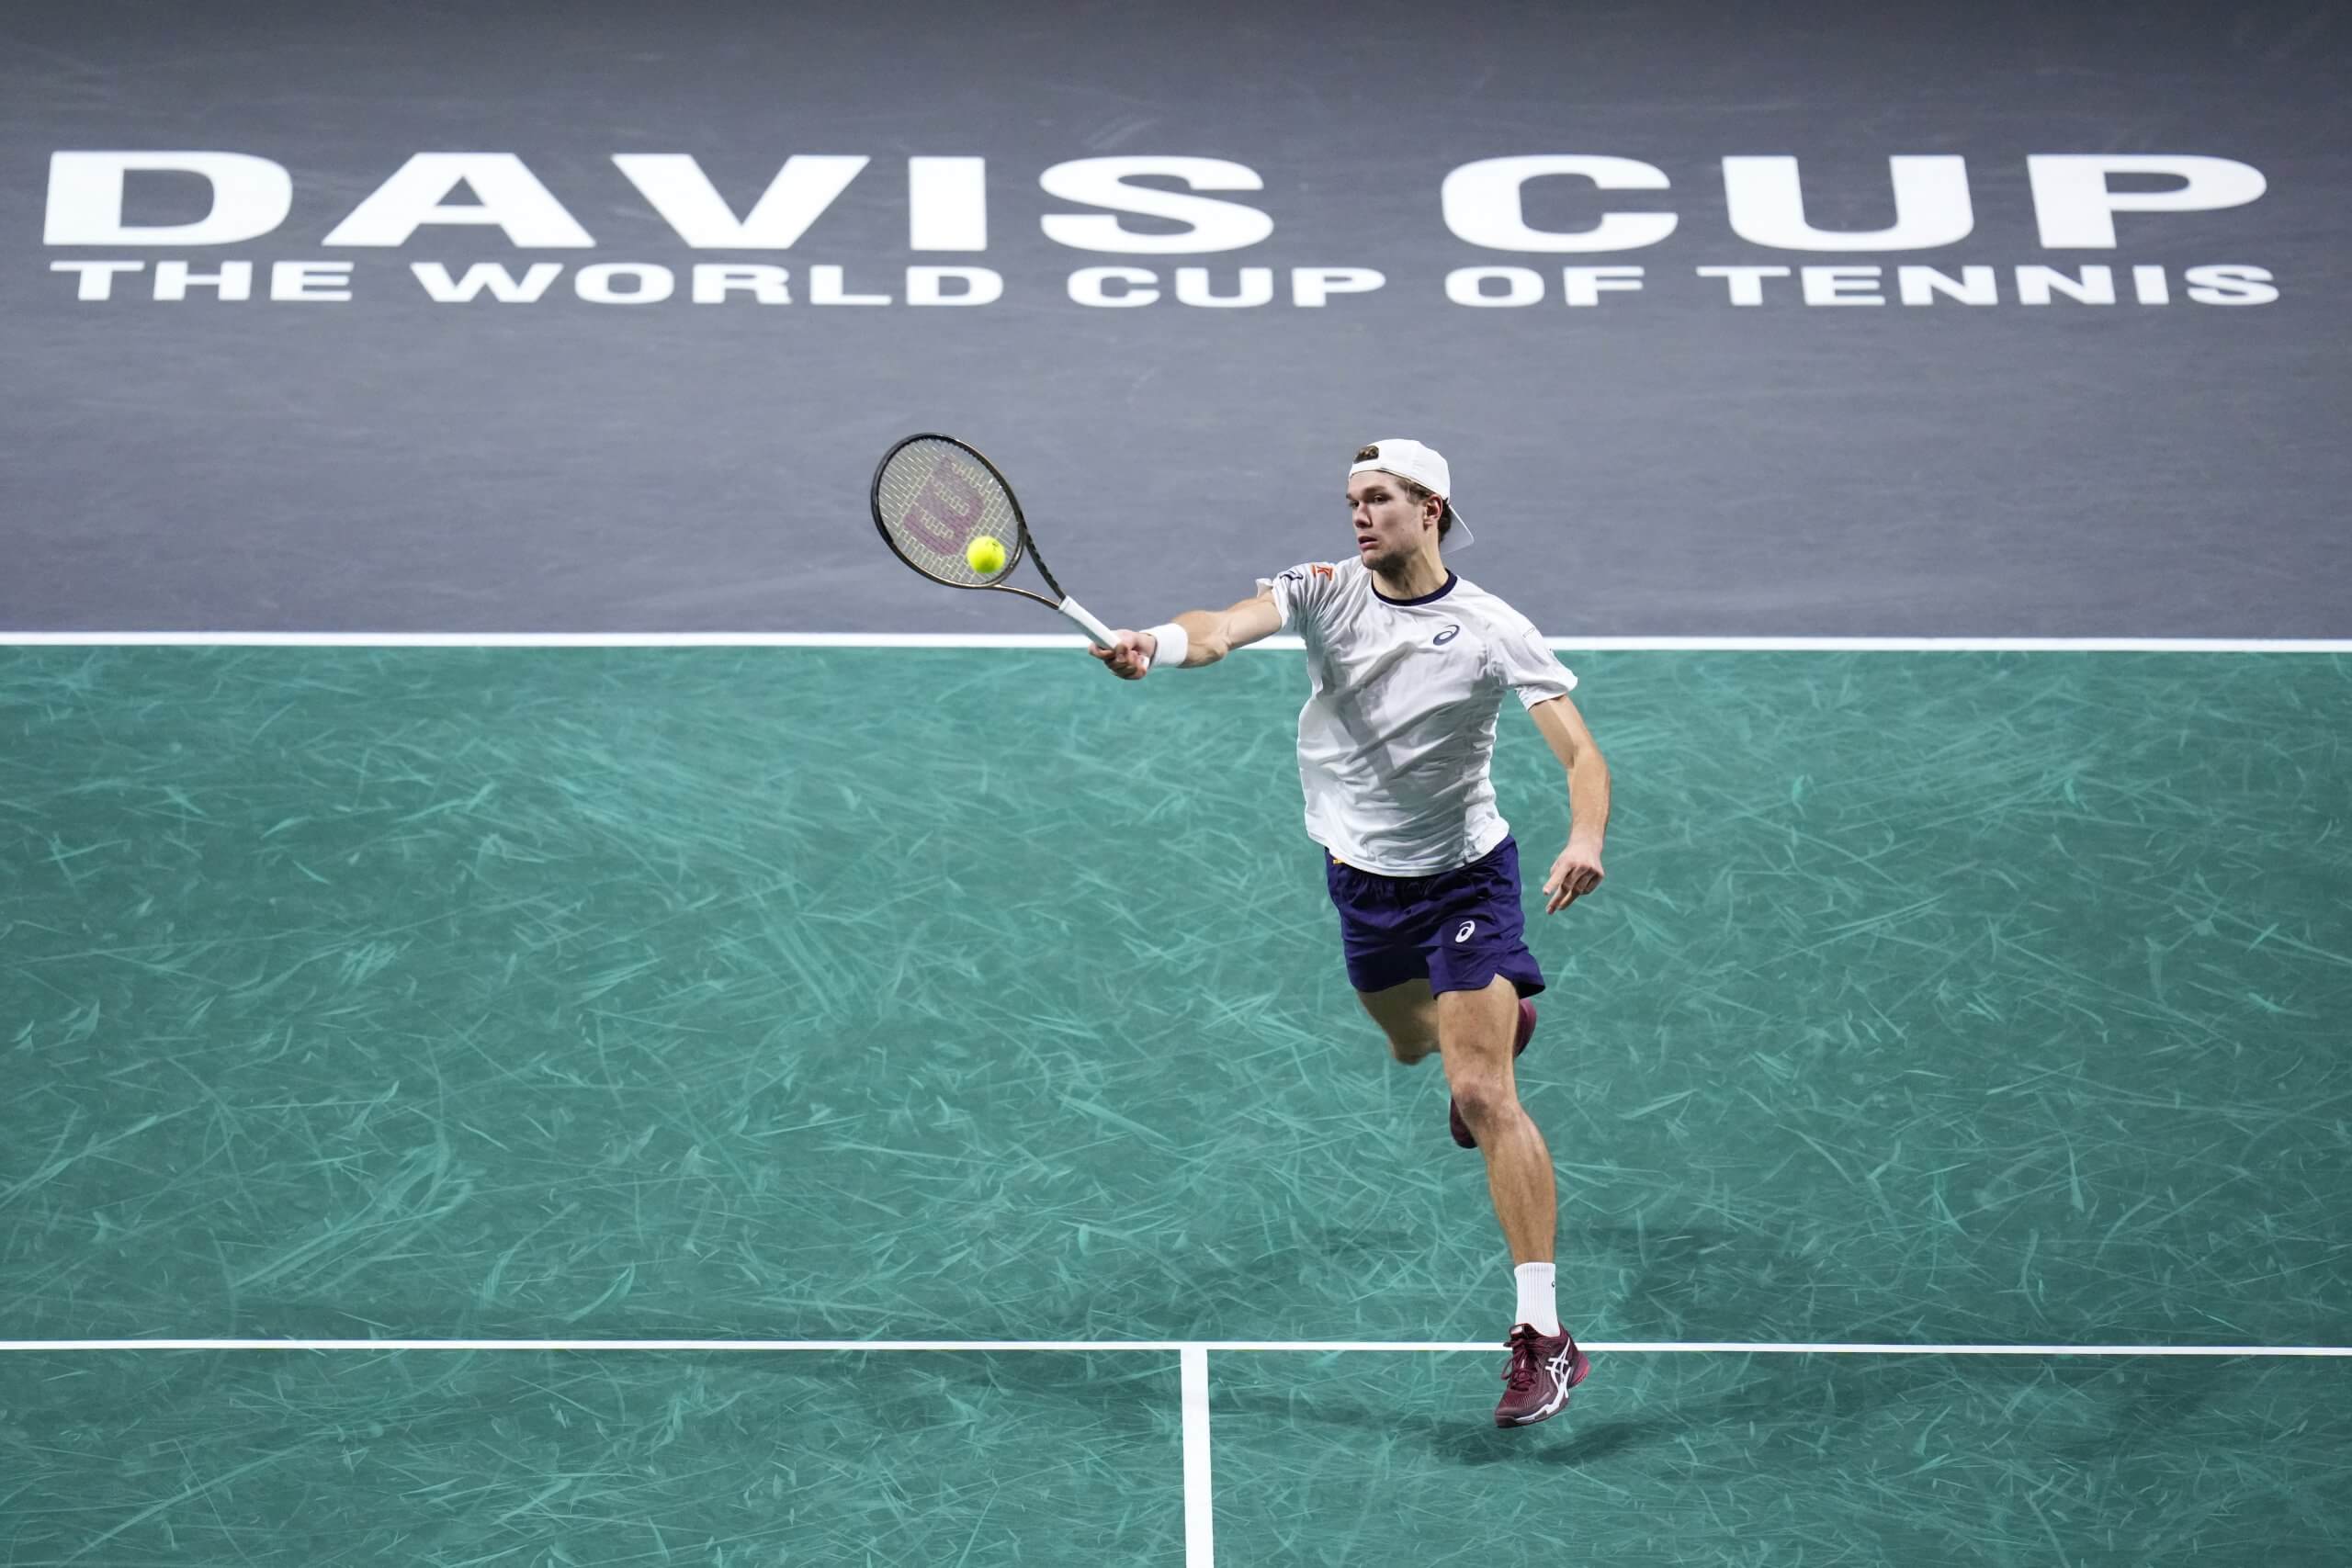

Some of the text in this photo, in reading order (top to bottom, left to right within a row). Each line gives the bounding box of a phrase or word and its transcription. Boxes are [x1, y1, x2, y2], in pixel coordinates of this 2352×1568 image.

[43, 151, 2267, 255] DAVIS CUP
[50, 260, 2279, 309] THE WORLD CUP OF TENNIS
